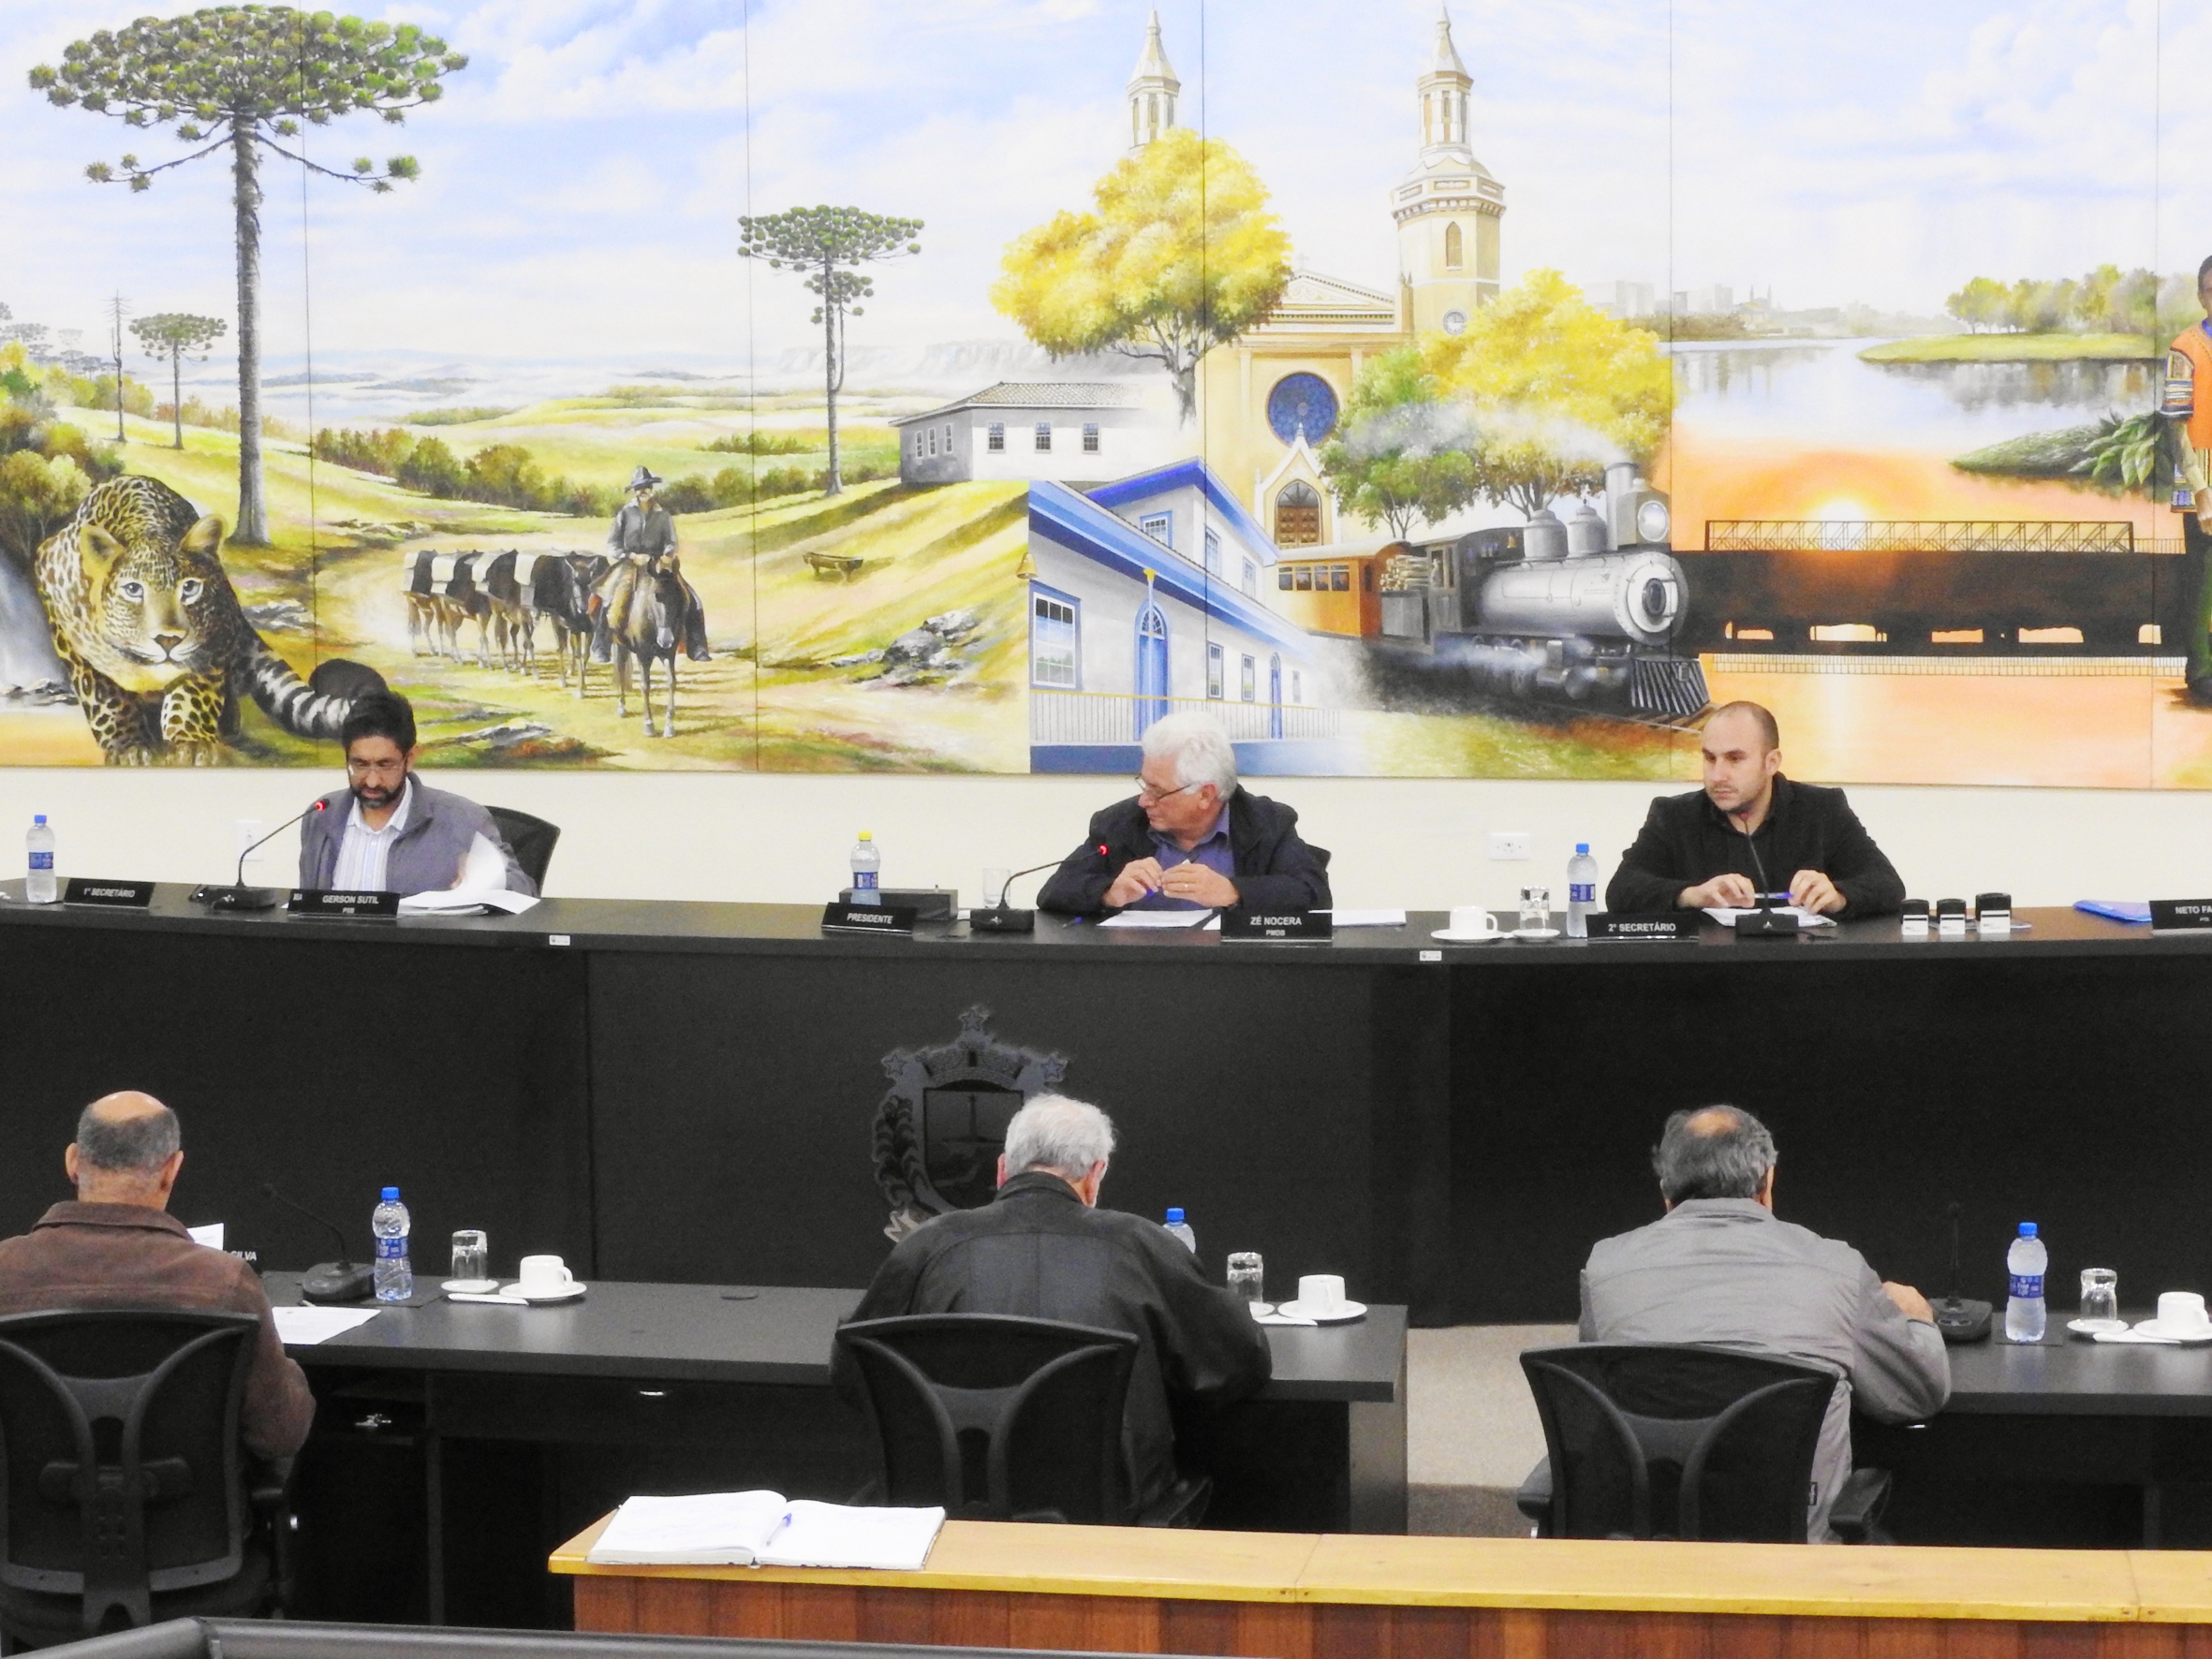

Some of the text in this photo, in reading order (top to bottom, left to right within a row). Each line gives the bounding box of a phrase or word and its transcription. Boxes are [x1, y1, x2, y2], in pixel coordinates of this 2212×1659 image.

[91, 887, 136, 898] SECRETÁRIO
[322, 894, 379, 904] GERSON SUTIL
[2175, 905, 2201, 915] NETO
[847, 913, 893, 924] PRESIDENTE
[1250, 915, 1302, 926] ZÉ NOCERA
[1618, 921, 1676, 932] SECRETÁRIO
